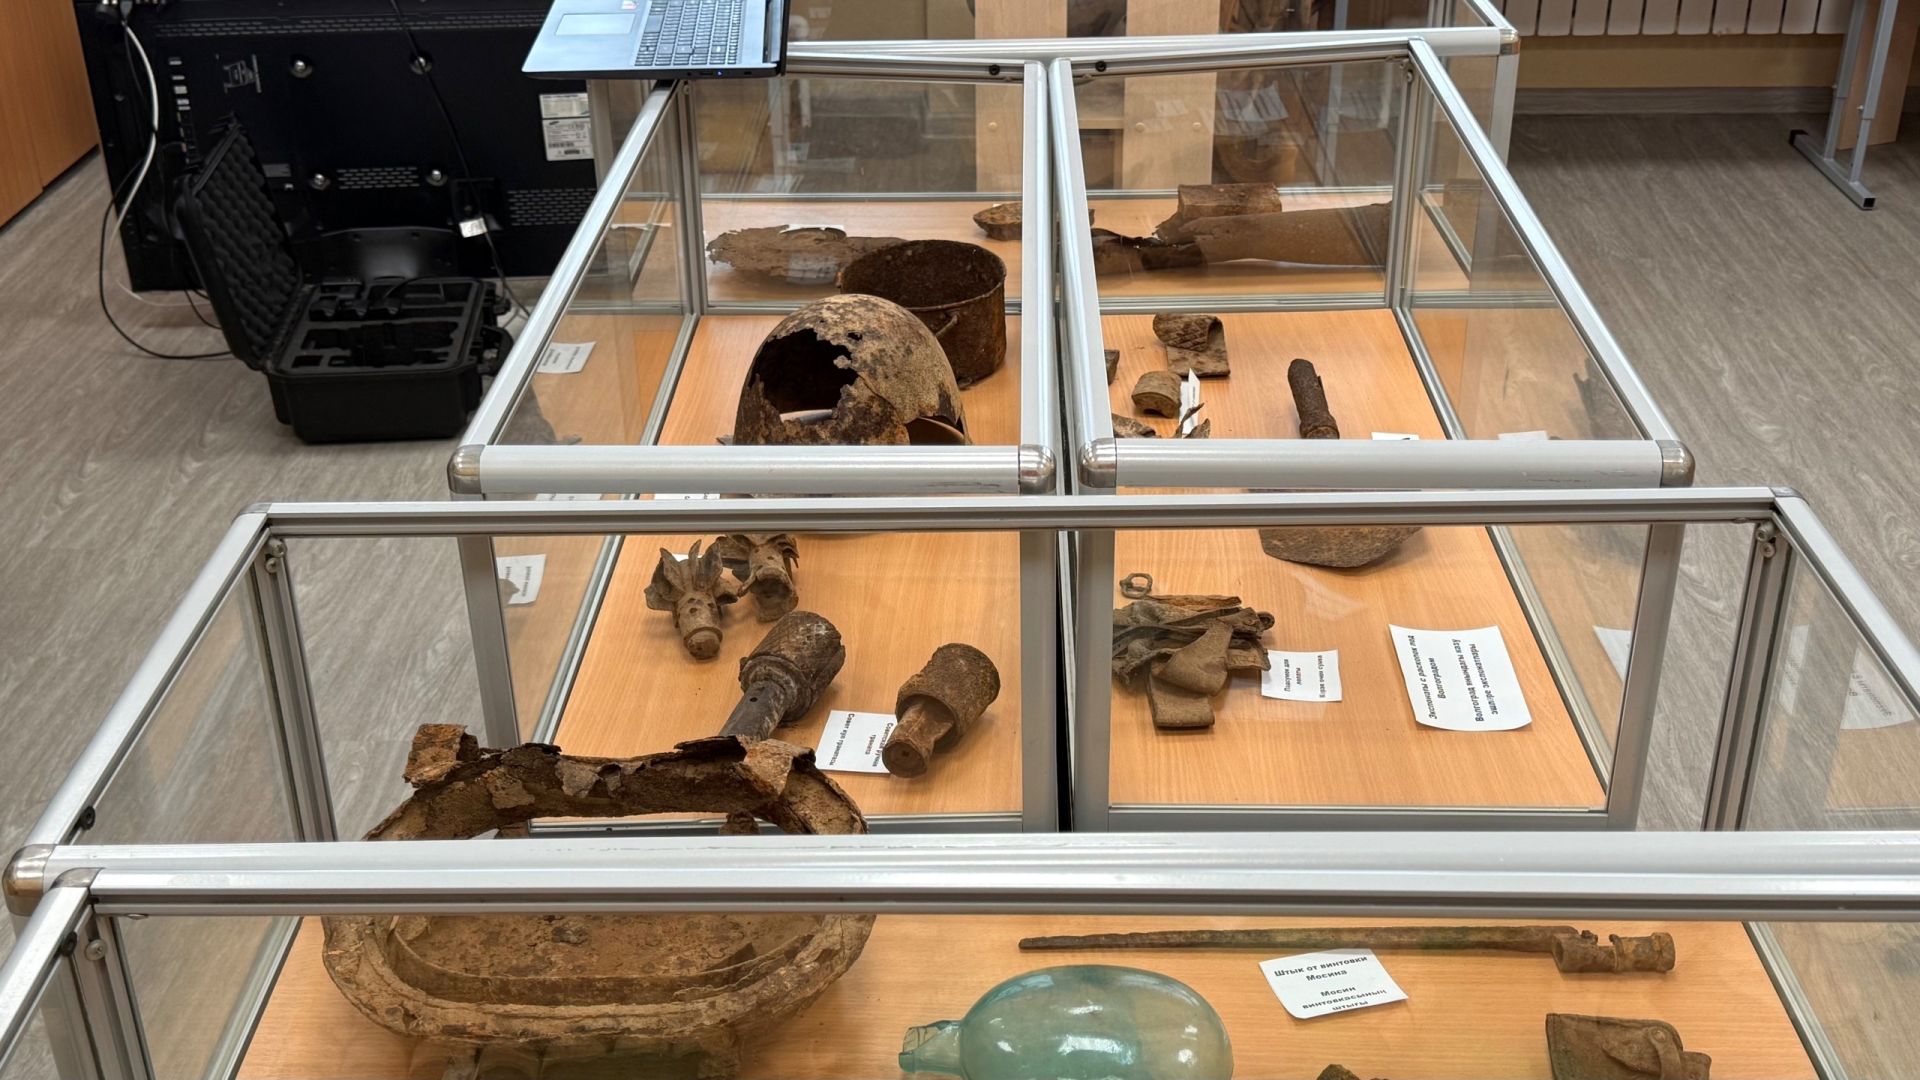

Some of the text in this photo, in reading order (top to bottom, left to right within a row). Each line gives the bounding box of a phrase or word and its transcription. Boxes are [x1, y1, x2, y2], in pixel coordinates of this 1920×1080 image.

[1408, 635, 1417, 646] под
[1411, 647, 1427, 677] раскопок
[1428, 657, 1446, 699] Волгоградом
[1420, 683, 1438, 720] Экспонаты
[1467, 686, 1484, 722] Волгоград
[1274, 967, 1305, 977] Штык
[1320, 956, 1368, 969] винтовки
[1306, 969, 1348, 982] Мосина
[1320, 986, 1356, 997] Мосин
